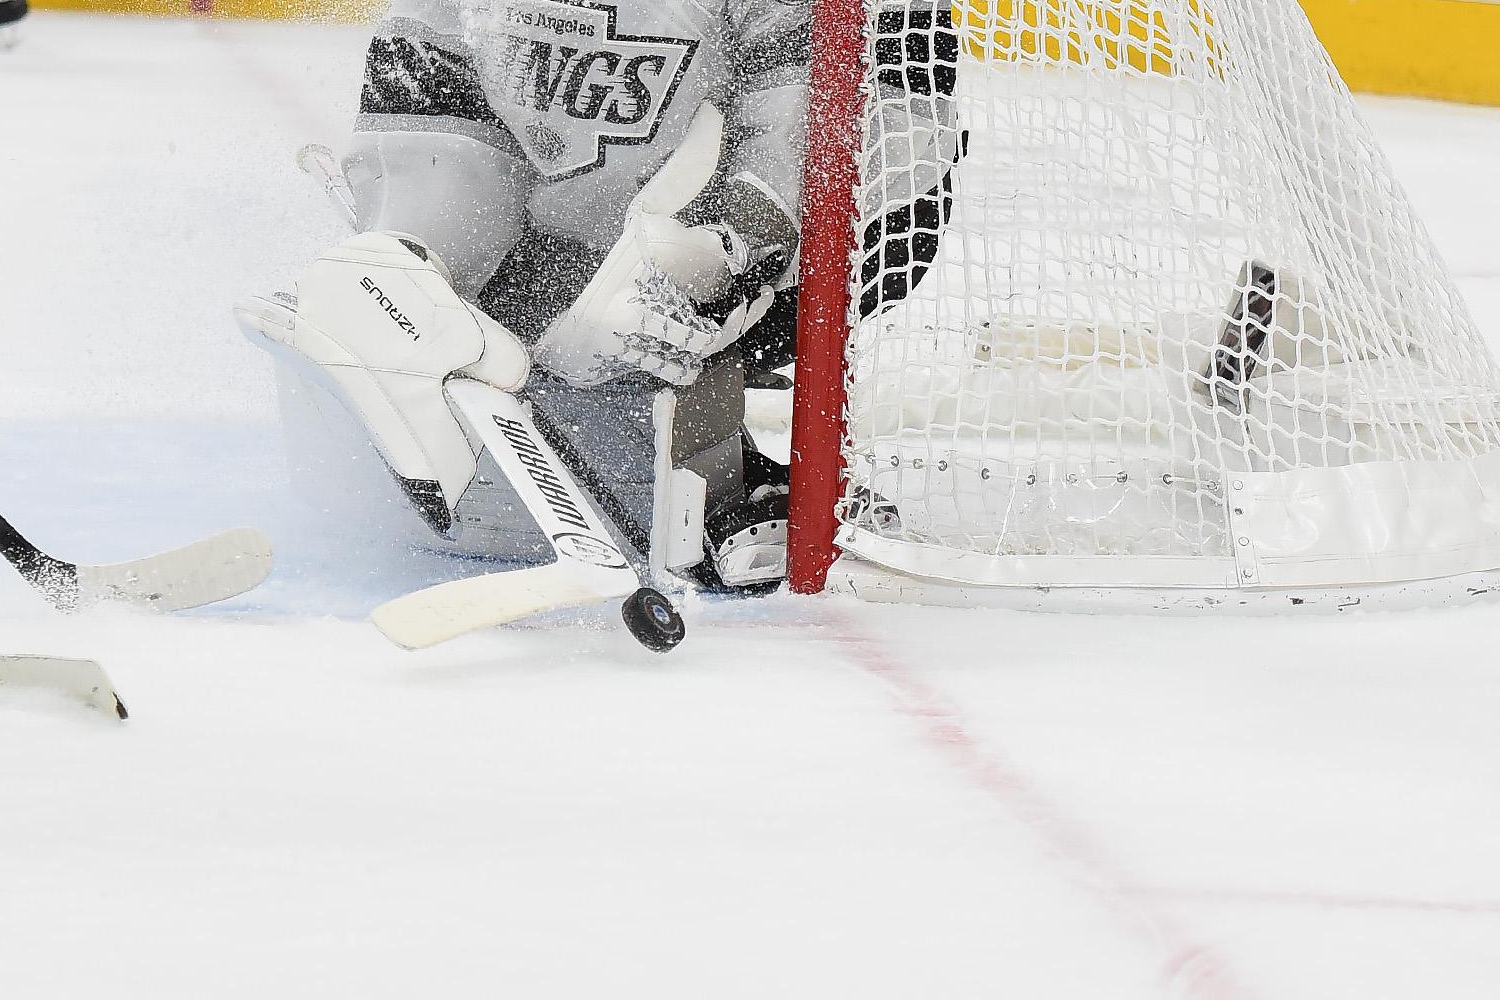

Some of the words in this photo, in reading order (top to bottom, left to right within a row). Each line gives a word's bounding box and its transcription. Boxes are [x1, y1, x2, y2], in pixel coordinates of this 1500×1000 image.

[534, 12, 595, 37] Angeles
[359, 276, 421, 342] HZRDUS
[491, 413, 592, 531] WARRIOR
